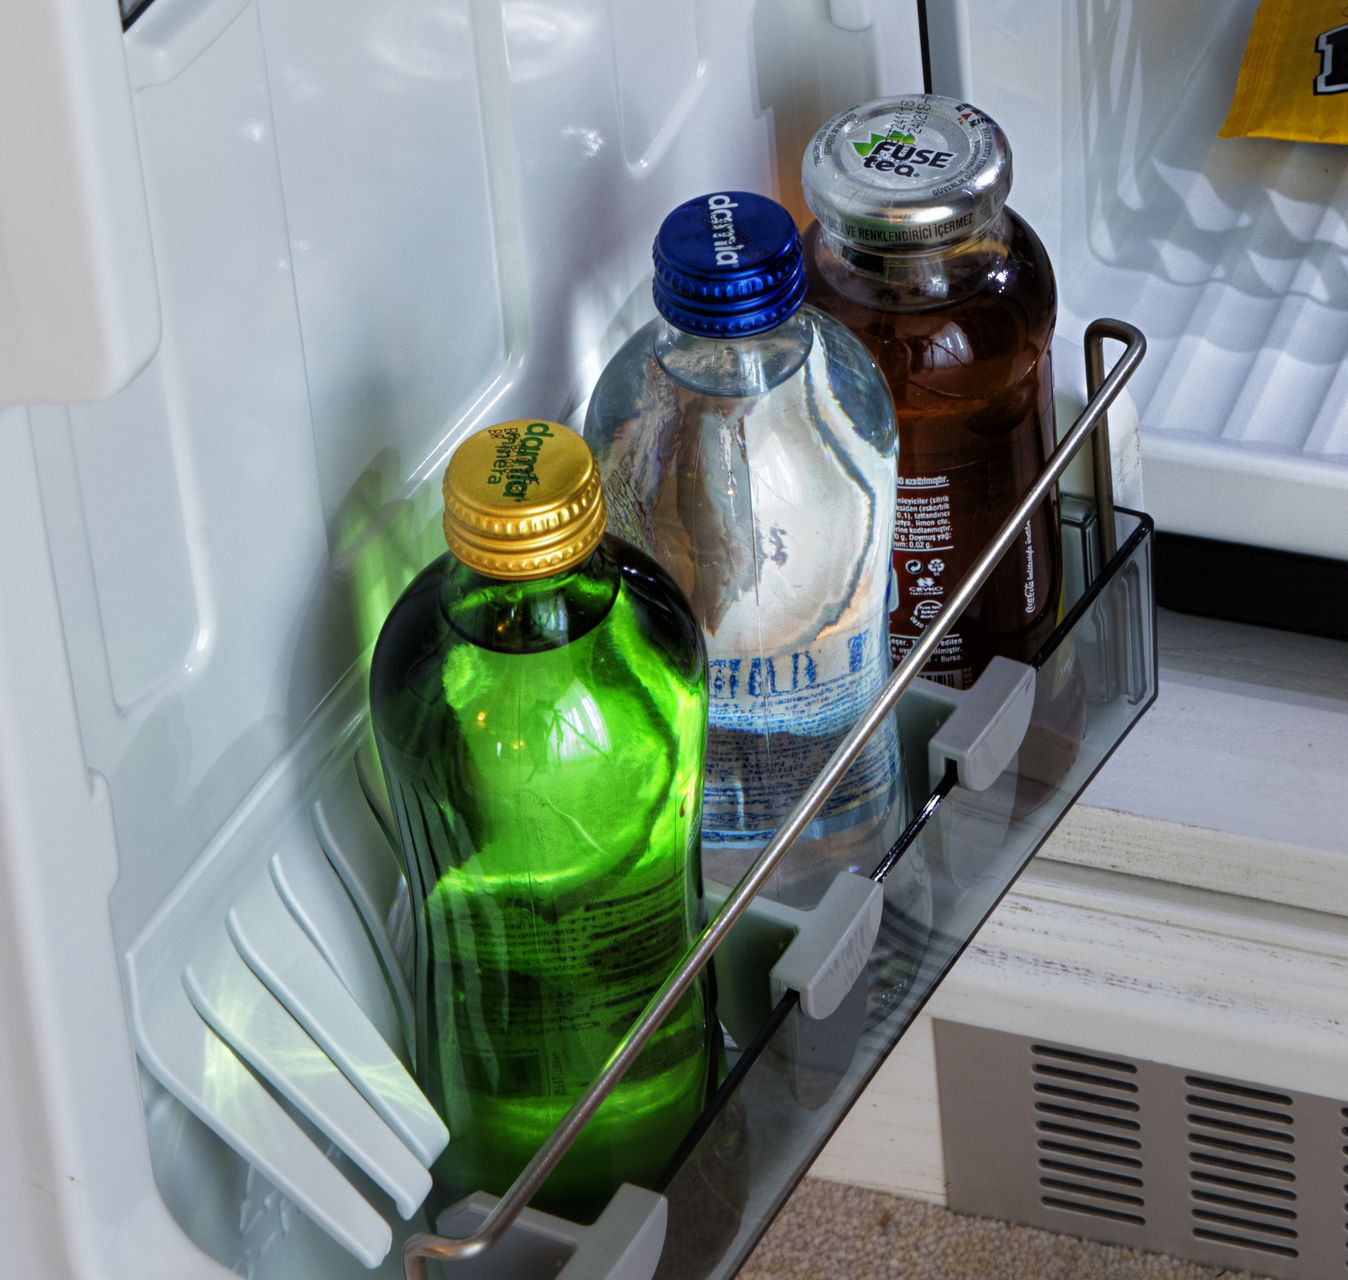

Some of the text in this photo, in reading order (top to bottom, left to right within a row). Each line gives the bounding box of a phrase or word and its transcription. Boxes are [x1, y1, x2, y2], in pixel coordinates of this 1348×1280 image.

[871, 141, 954, 169] FUSE
[846, 225, 858, 238] VE
[858, 223, 933, 244] RENKLENDİRİCİ
[934, 212, 974, 238] İÇERMEZ
[929, 495, 950, 505] (sitrik
[918, 503, 950, 514] (askorbik
[915, 519, 936, 527] limon
